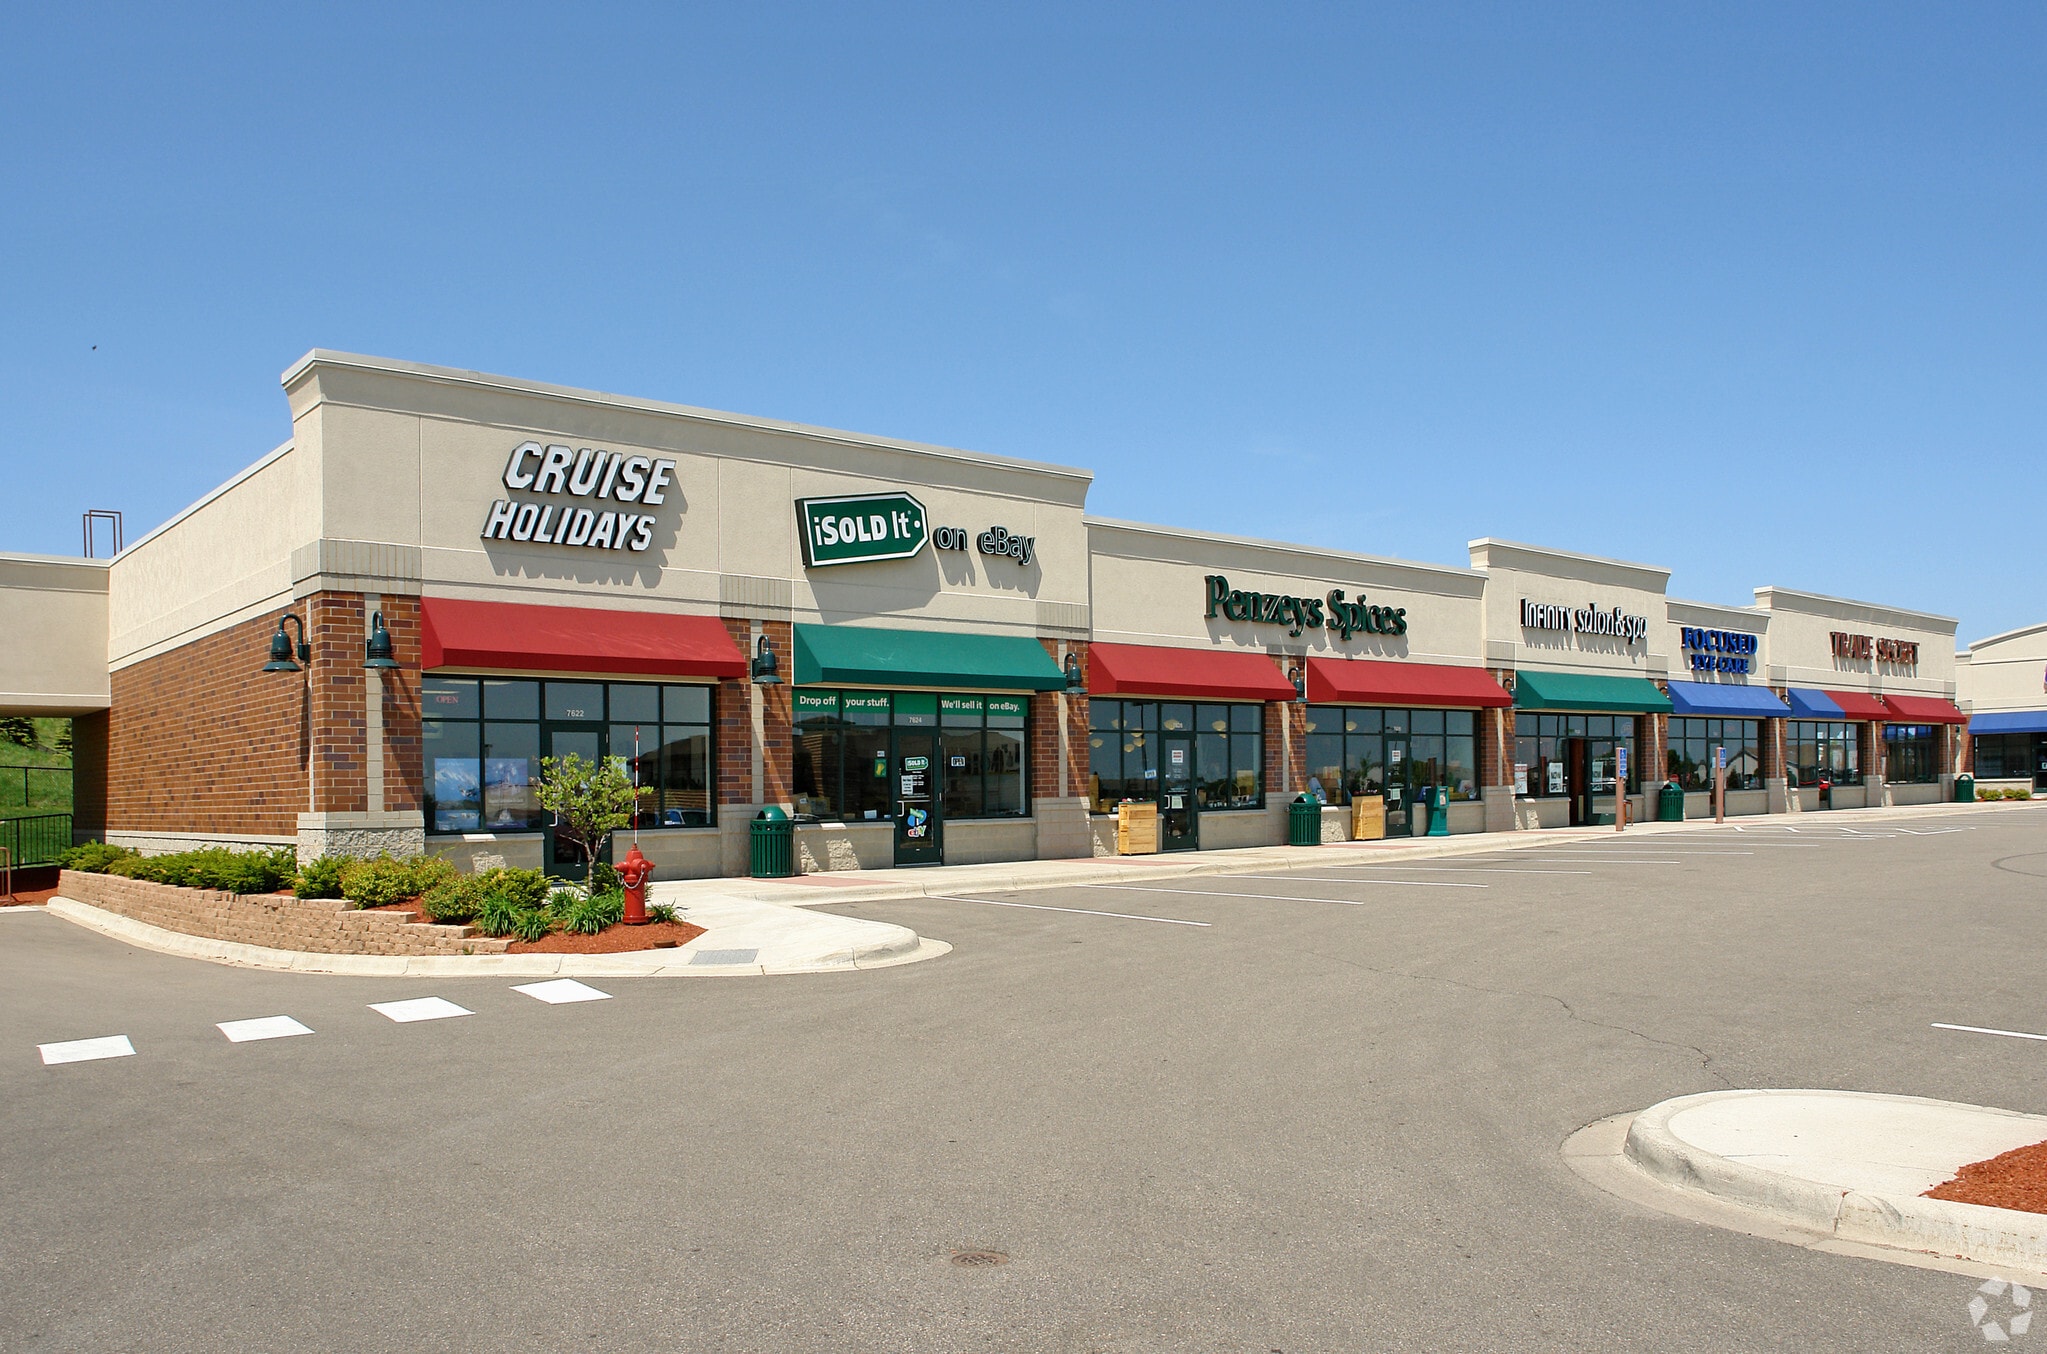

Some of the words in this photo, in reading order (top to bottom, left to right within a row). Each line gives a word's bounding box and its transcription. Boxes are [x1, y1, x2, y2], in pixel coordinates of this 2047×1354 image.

[502, 440, 676, 505] CRUISE
[481, 500, 656, 551] HOLIDAYS
[813, 515, 887, 546] iSOLD
[891, 510, 911, 539] It
[933, 526, 968, 550] on
[976, 526, 1036, 566] eBay
[1204, 575, 1325, 637] Penzeys
[1326, 588, 1408, 641] Spices
[1680, 626, 1758, 655] FOCUSED
[1829, 631, 1873, 660] TRADE
[1690, 654, 1716, 671] EYE
[1716, 656, 1749, 674] CARE
[436, 695, 459, 704] OPEN
[566, 709, 584, 717] 7622
[799, 696, 822, 707] Drop
[823, 696, 837, 705] off
[845, 698, 865, 708] your
[867, 697, 890, 707] stuff.
[941, 700, 960, 709] We'll
[961, 700, 975, 709] sell
[976, 701, 983, 709] it
[1000, 702, 1020, 712] eBay.
[908, 716, 922, 724] 7624
